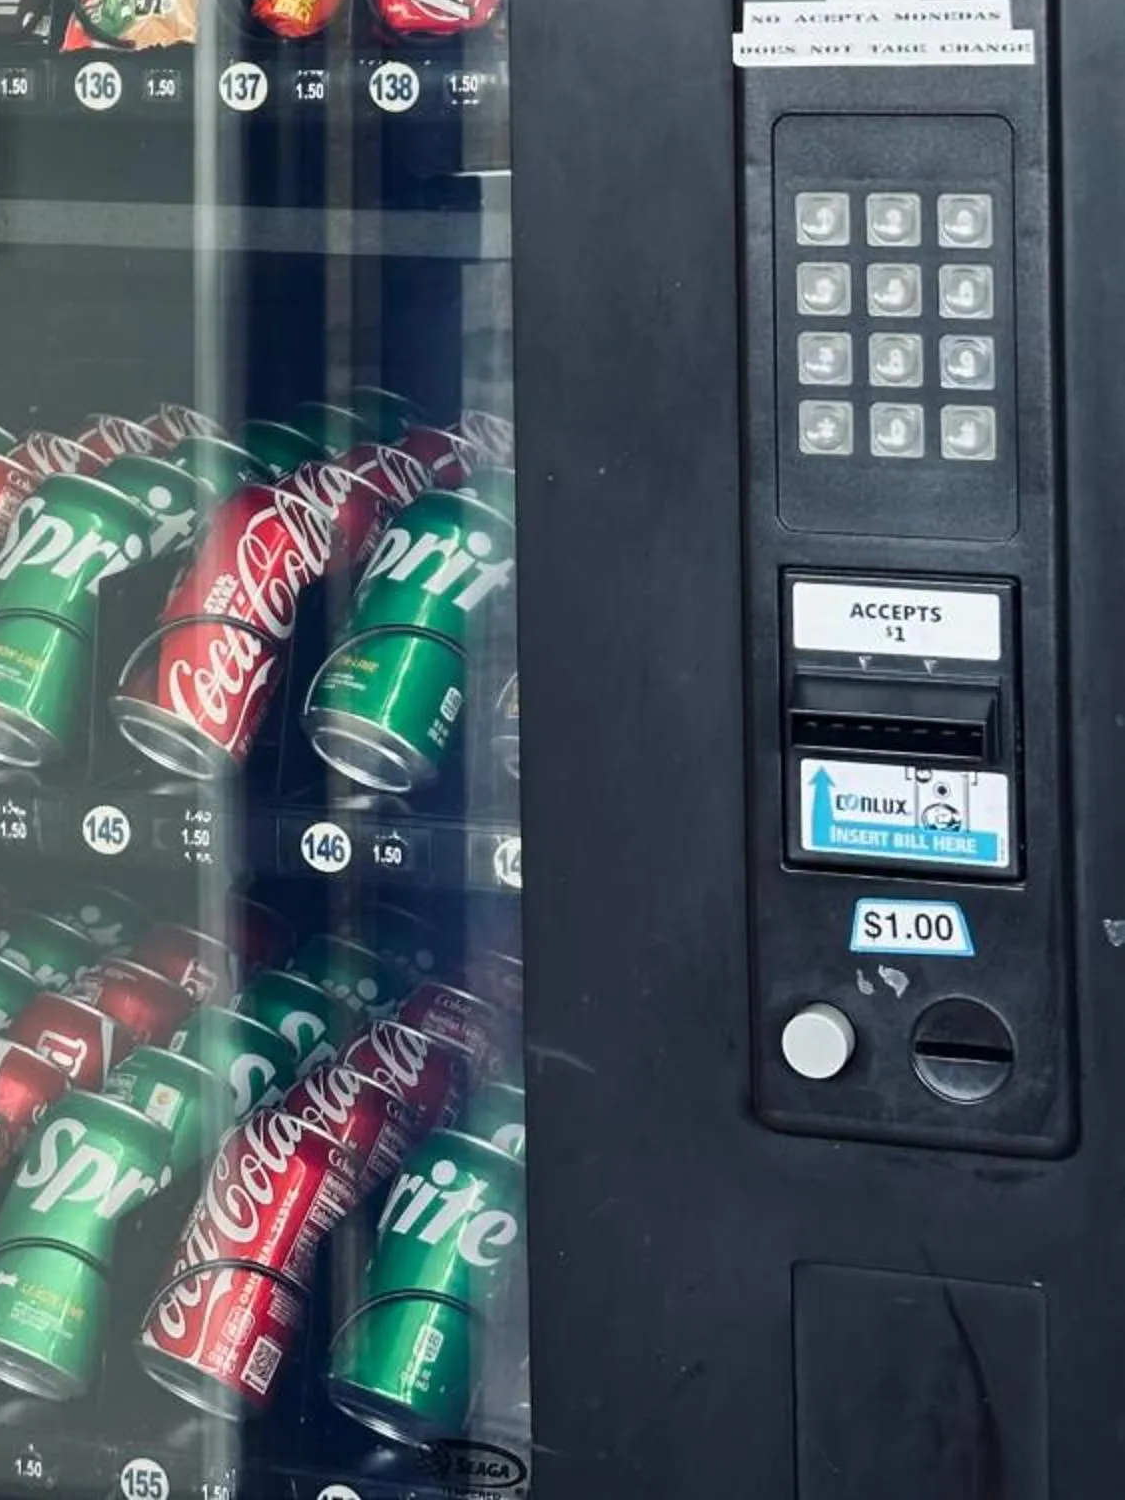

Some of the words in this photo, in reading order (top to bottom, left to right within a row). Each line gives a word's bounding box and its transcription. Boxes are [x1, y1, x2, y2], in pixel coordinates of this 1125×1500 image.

[751, 13, 780, 24] NO
[794, 11, 881, 23] ACEPTA
[893, 10, 1003, 22] MONEDAS
[739, 44, 796, 55] DOES
[810, 43, 854, 55] NOT
[871, 43, 928, 54] TAKE
[940, 42, 1032, 54] CHANGE
[0, 77, 28, 95] 1.50
[77, 73, 114, 99] 136
[147, 79, 175, 96] 1.50
[222, 73, 262, 99] 137
[295, 82, 324, 100] 1.50
[372, 74, 412, 101] 138
[450, 74, 478, 92] 1.50
[849, 603, 943, 623] ACCEPTS
[885, 625, 906, 642] $1
[0, 822, 27, 839] 1.50
[84, 816, 125, 843] 145
[181, 828, 211, 847] 1.50
[830, 826, 889, 848] INSERT
[893, 829, 929, 850] BILL
[935, 833, 977, 852] HERE
[304, 833, 345, 861] 146
[373, 846, 402, 864] 1.50
[863, 911, 955, 941] $1.00
[379, 1160, 517, 1266] rite
[16, 1459, 43, 1477] 1.50
[123, 1471, 164, 1498] 155
